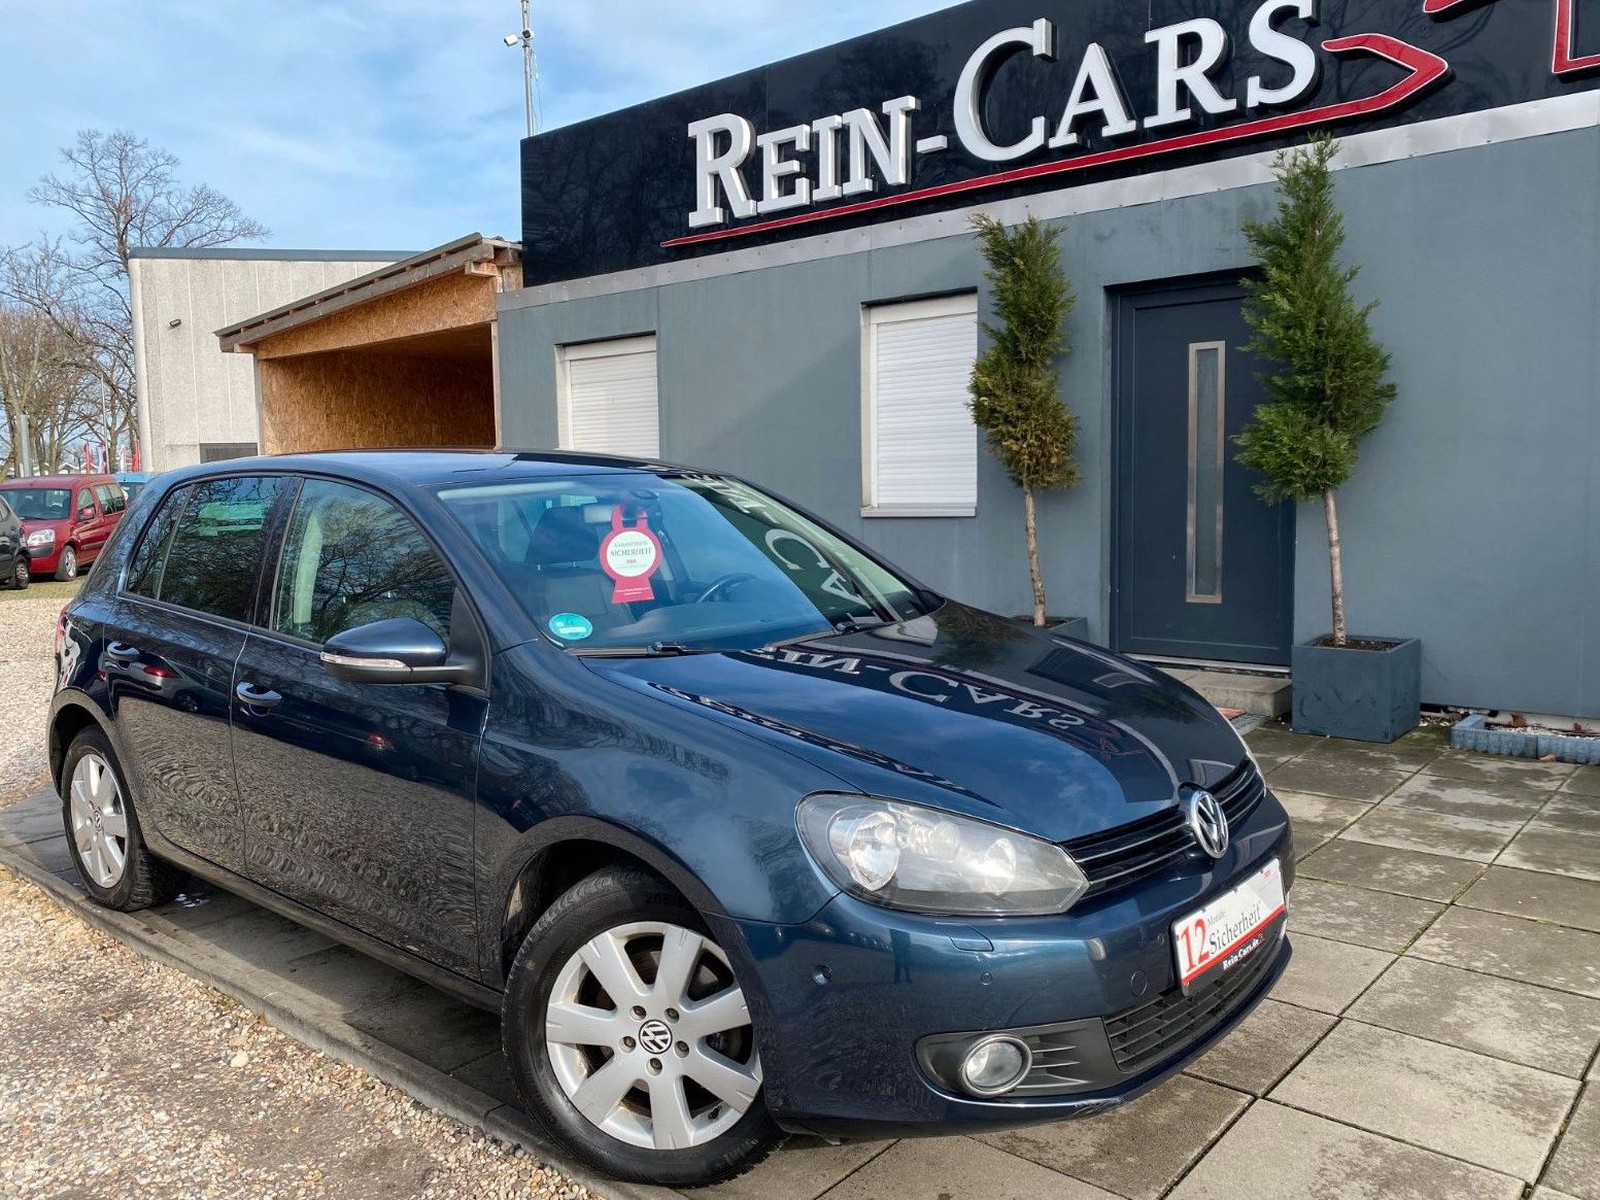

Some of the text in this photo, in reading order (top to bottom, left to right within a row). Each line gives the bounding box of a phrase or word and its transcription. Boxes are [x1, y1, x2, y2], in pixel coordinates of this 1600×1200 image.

[688, 0, 1316, 228] REIN-CARS
[1181, 902, 1260, 972] 12 Sicherheit
